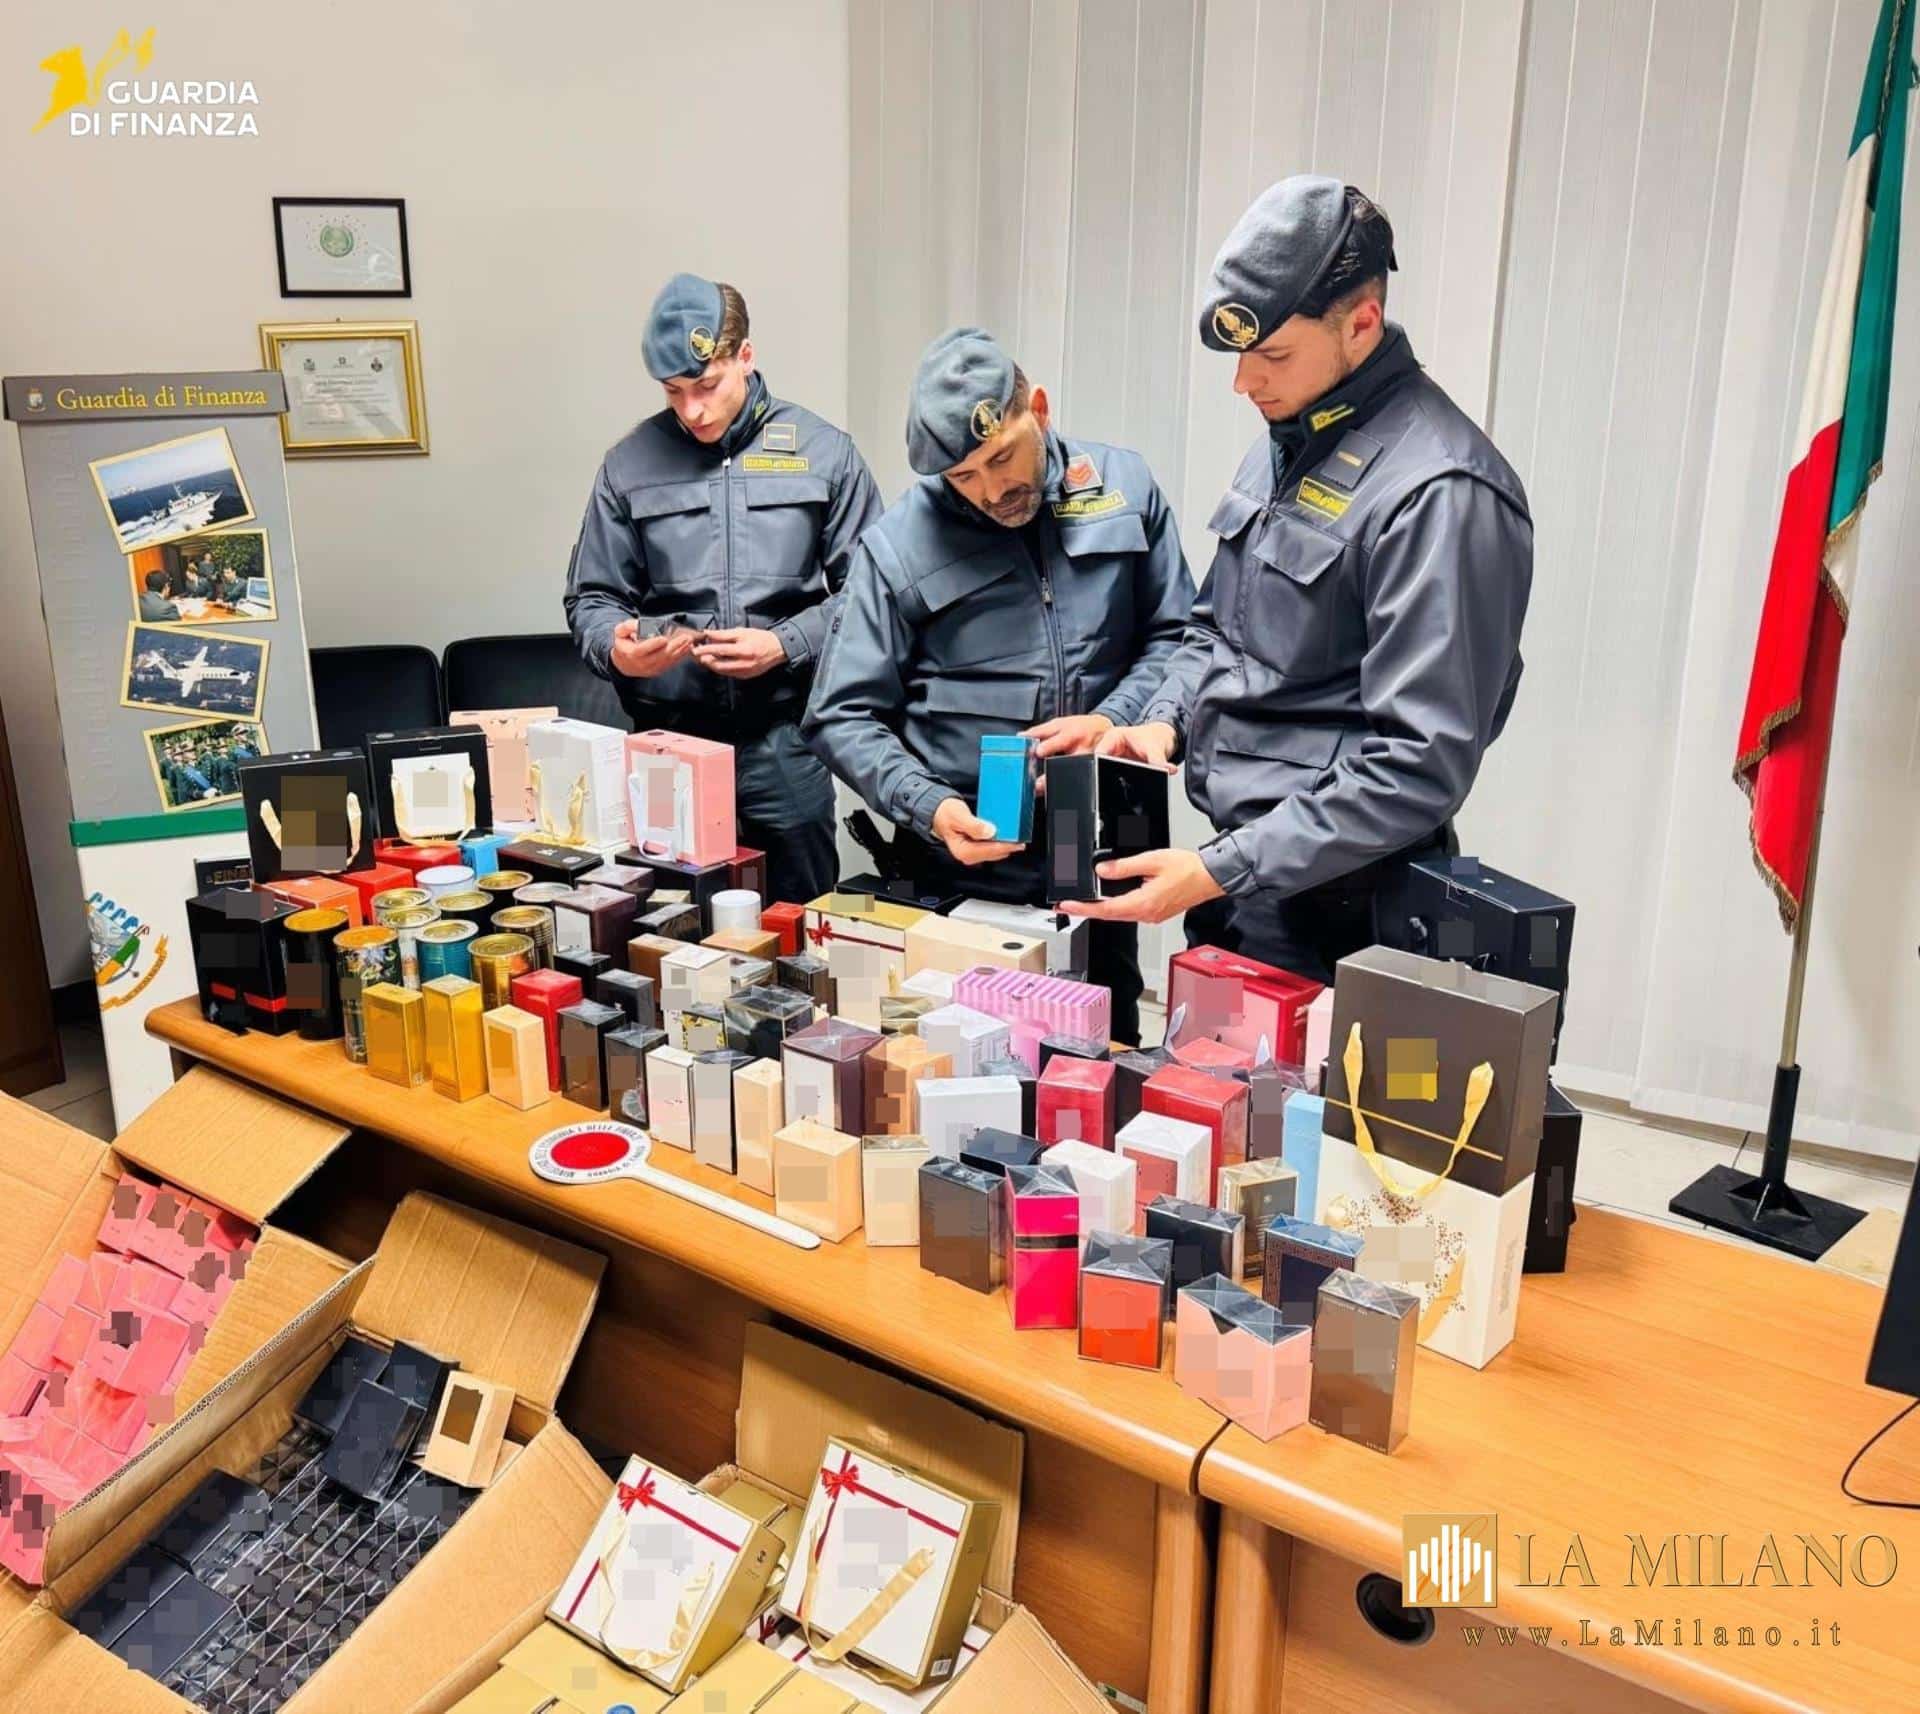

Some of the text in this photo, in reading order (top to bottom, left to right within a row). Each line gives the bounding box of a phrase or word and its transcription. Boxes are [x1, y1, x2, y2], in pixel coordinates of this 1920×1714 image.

[56, 384, 267, 409] Guardia di Finanza
